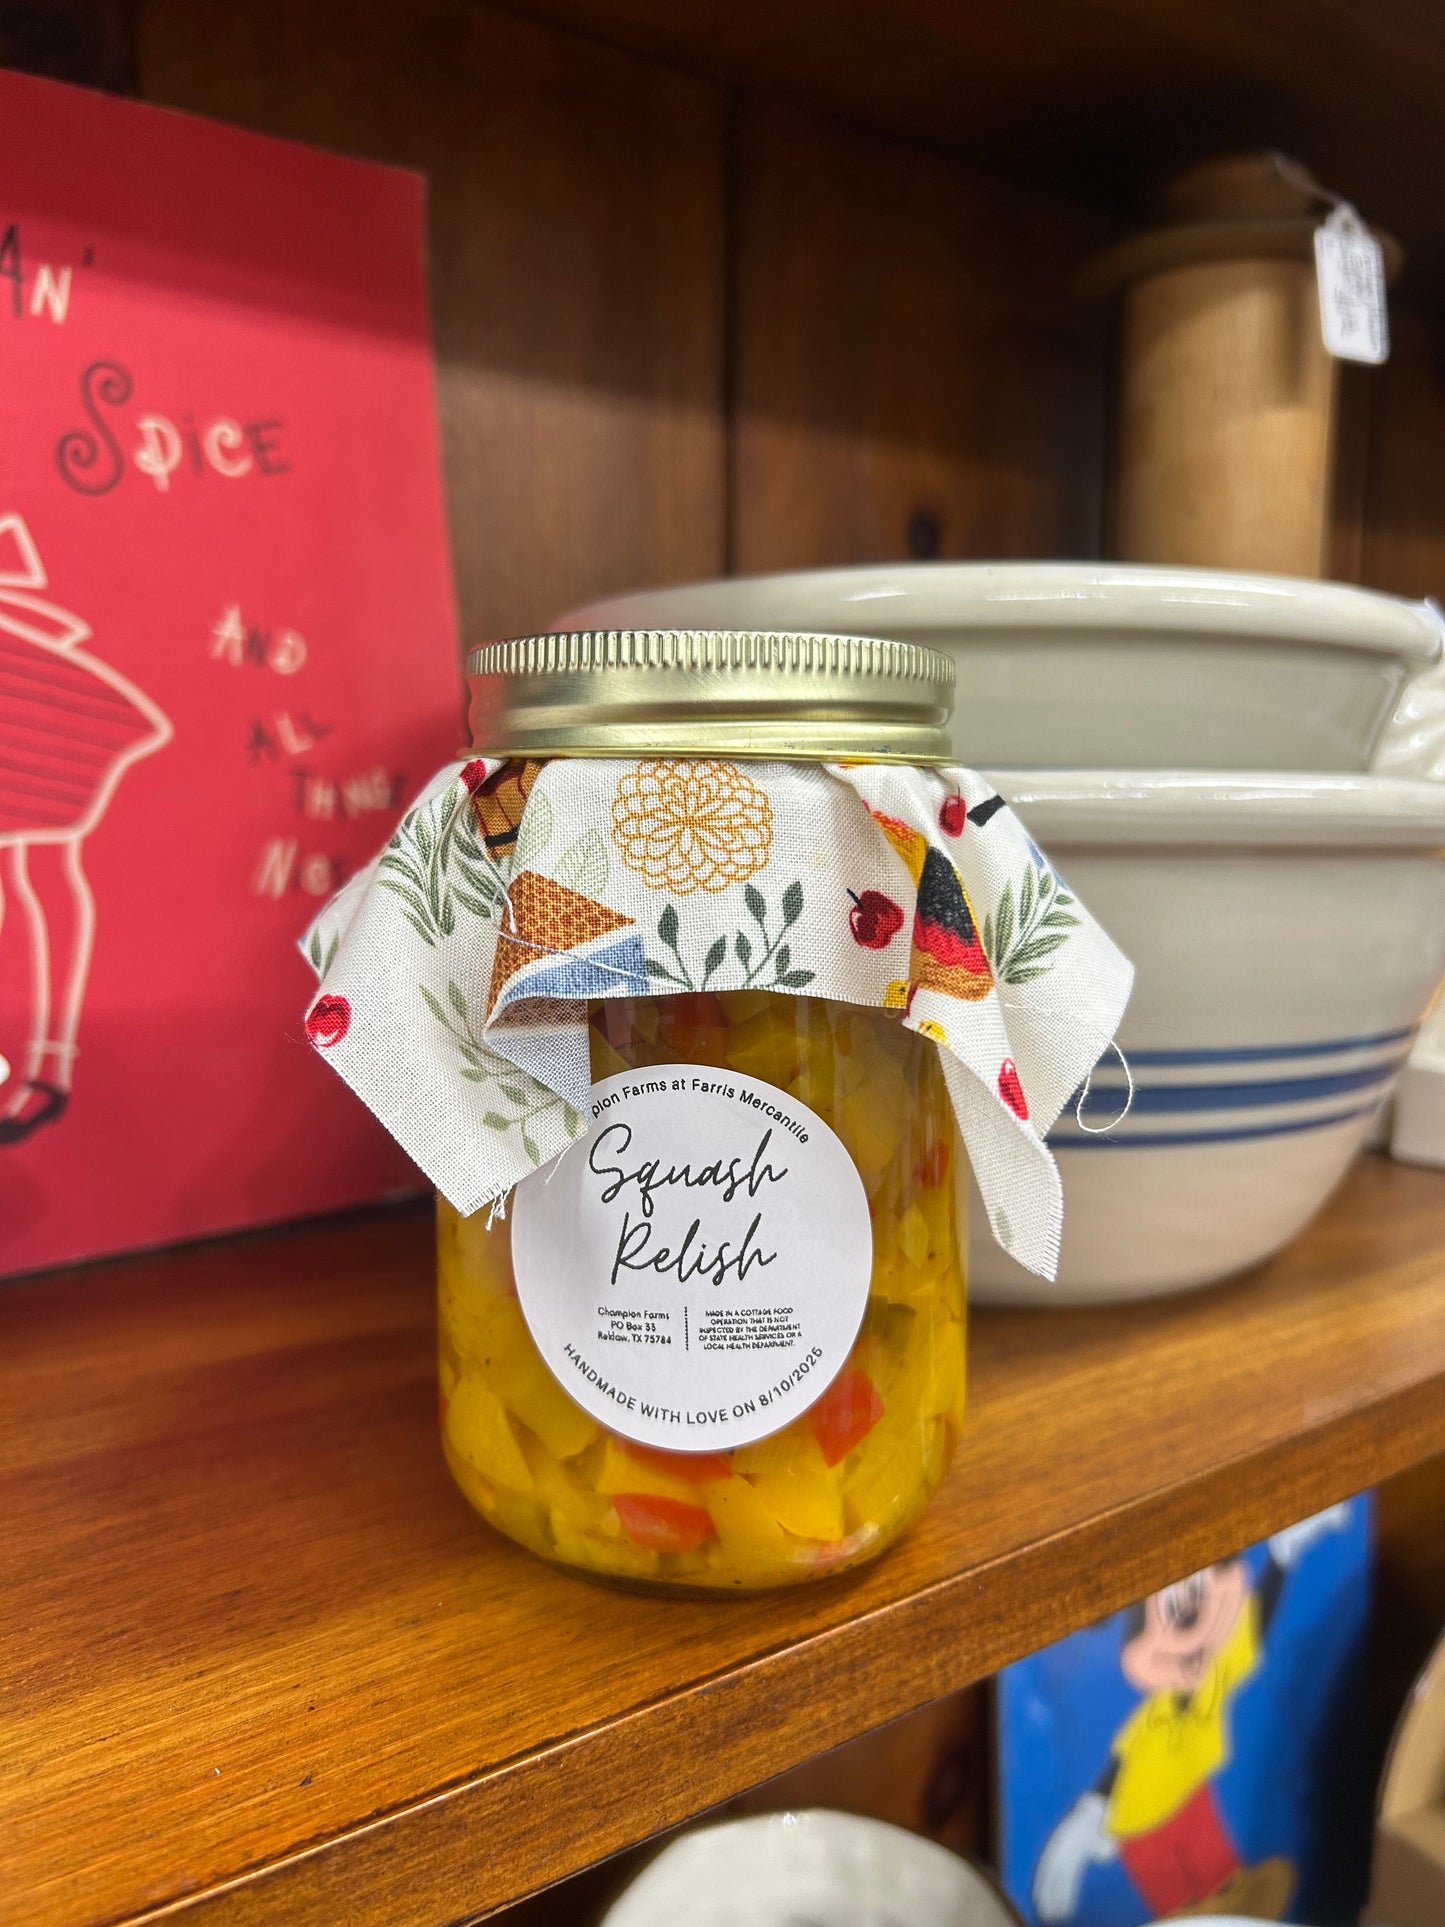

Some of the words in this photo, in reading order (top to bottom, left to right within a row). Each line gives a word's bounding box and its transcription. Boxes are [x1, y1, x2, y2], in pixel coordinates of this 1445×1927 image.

[622, 1079, 667, 1099] Farms
[672, 1078, 686, 1091] at
[692, 1078, 735, 1099] Farris
[739, 1089, 809, 1145] Mercantile
[588, 1123, 788, 1217] Squash
[610, 1212, 777, 1286] Relish
[597, 1306, 641, 1319] Champion
[644, 1310, 670, 1320] Farms
[705, 1309, 724, 1317] MADE
[740, 1308, 771, 1316] COTTAGE
[773, 1307, 794, 1315] FOOD
[611, 1320, 624, 1330] PO
[626, 1321, 643, 1331] Box
[645, 1322, 656, 1332] 33
[710, 1317, 748, 1325] OPERATION
[767, 1316, 773, 1324] IS
[699, 1326, 734, 1334] INSPECTED
[745, 1325, 757, 1333] THE
[759, 1323, 801, 1332] DEPARTMENT
[631, 1333, 642, 1343] TX
[644, 1334, 672, 1344] 75784
[729, 1333, 753, 1341] HEALTH
[754, 1332, 784, 1340] SERVICES
[785, 1331, 796, 1339] OR
[726, 1342, 751, 1350] HEALTH
[563, 1343, 637, 1410] HANDMADE
[640, 1403, 681, 1424] WITH
[686, 1409, 729, 1425] LOVE
[732, 1401, 757, 1418] ON
[758, 1346, 824, 1407] 8/10/2025
